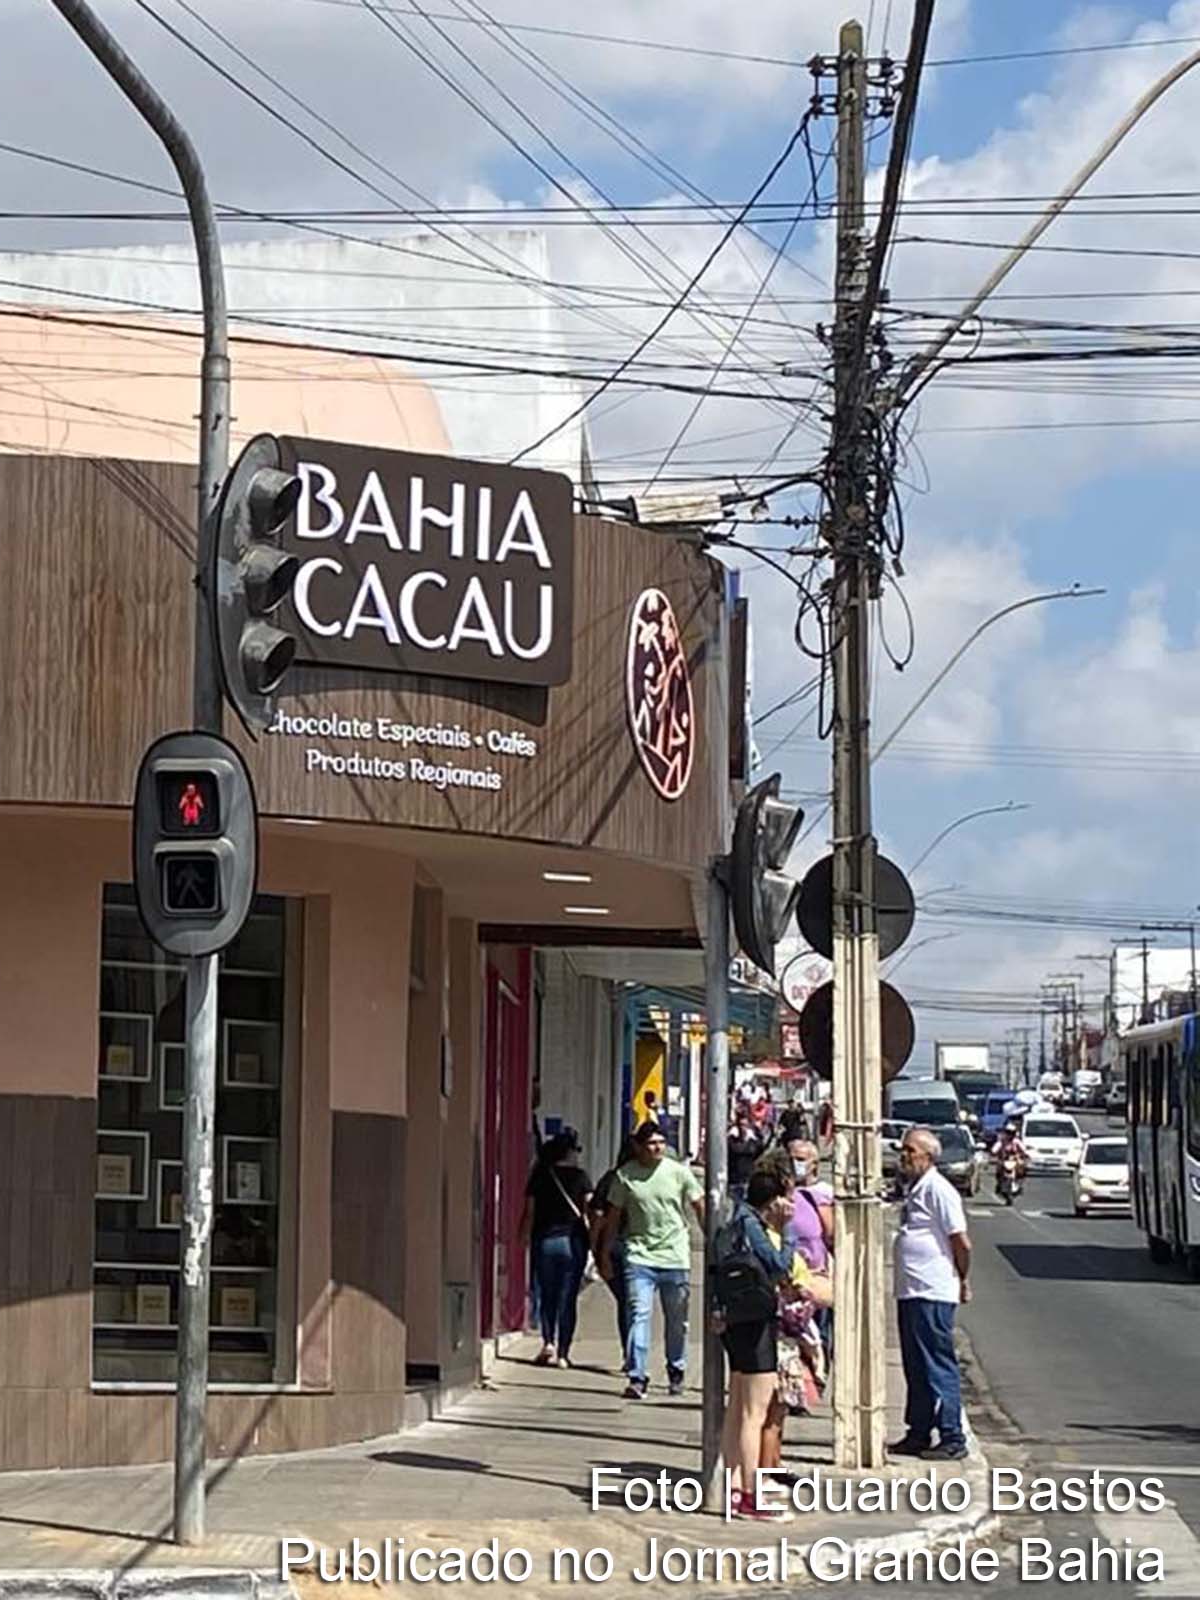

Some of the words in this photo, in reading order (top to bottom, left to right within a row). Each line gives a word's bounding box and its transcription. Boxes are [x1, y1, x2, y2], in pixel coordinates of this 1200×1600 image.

[296, 462, 552, 569] BAHIA
[294, 556, 554, 660] CACAU
[306, 749, 405, 780] Produtos
[410, 758, 502, 791] Regionais
[376, 717, 470, 749] Especiais
[487, 730, 537, 758] Cafés
